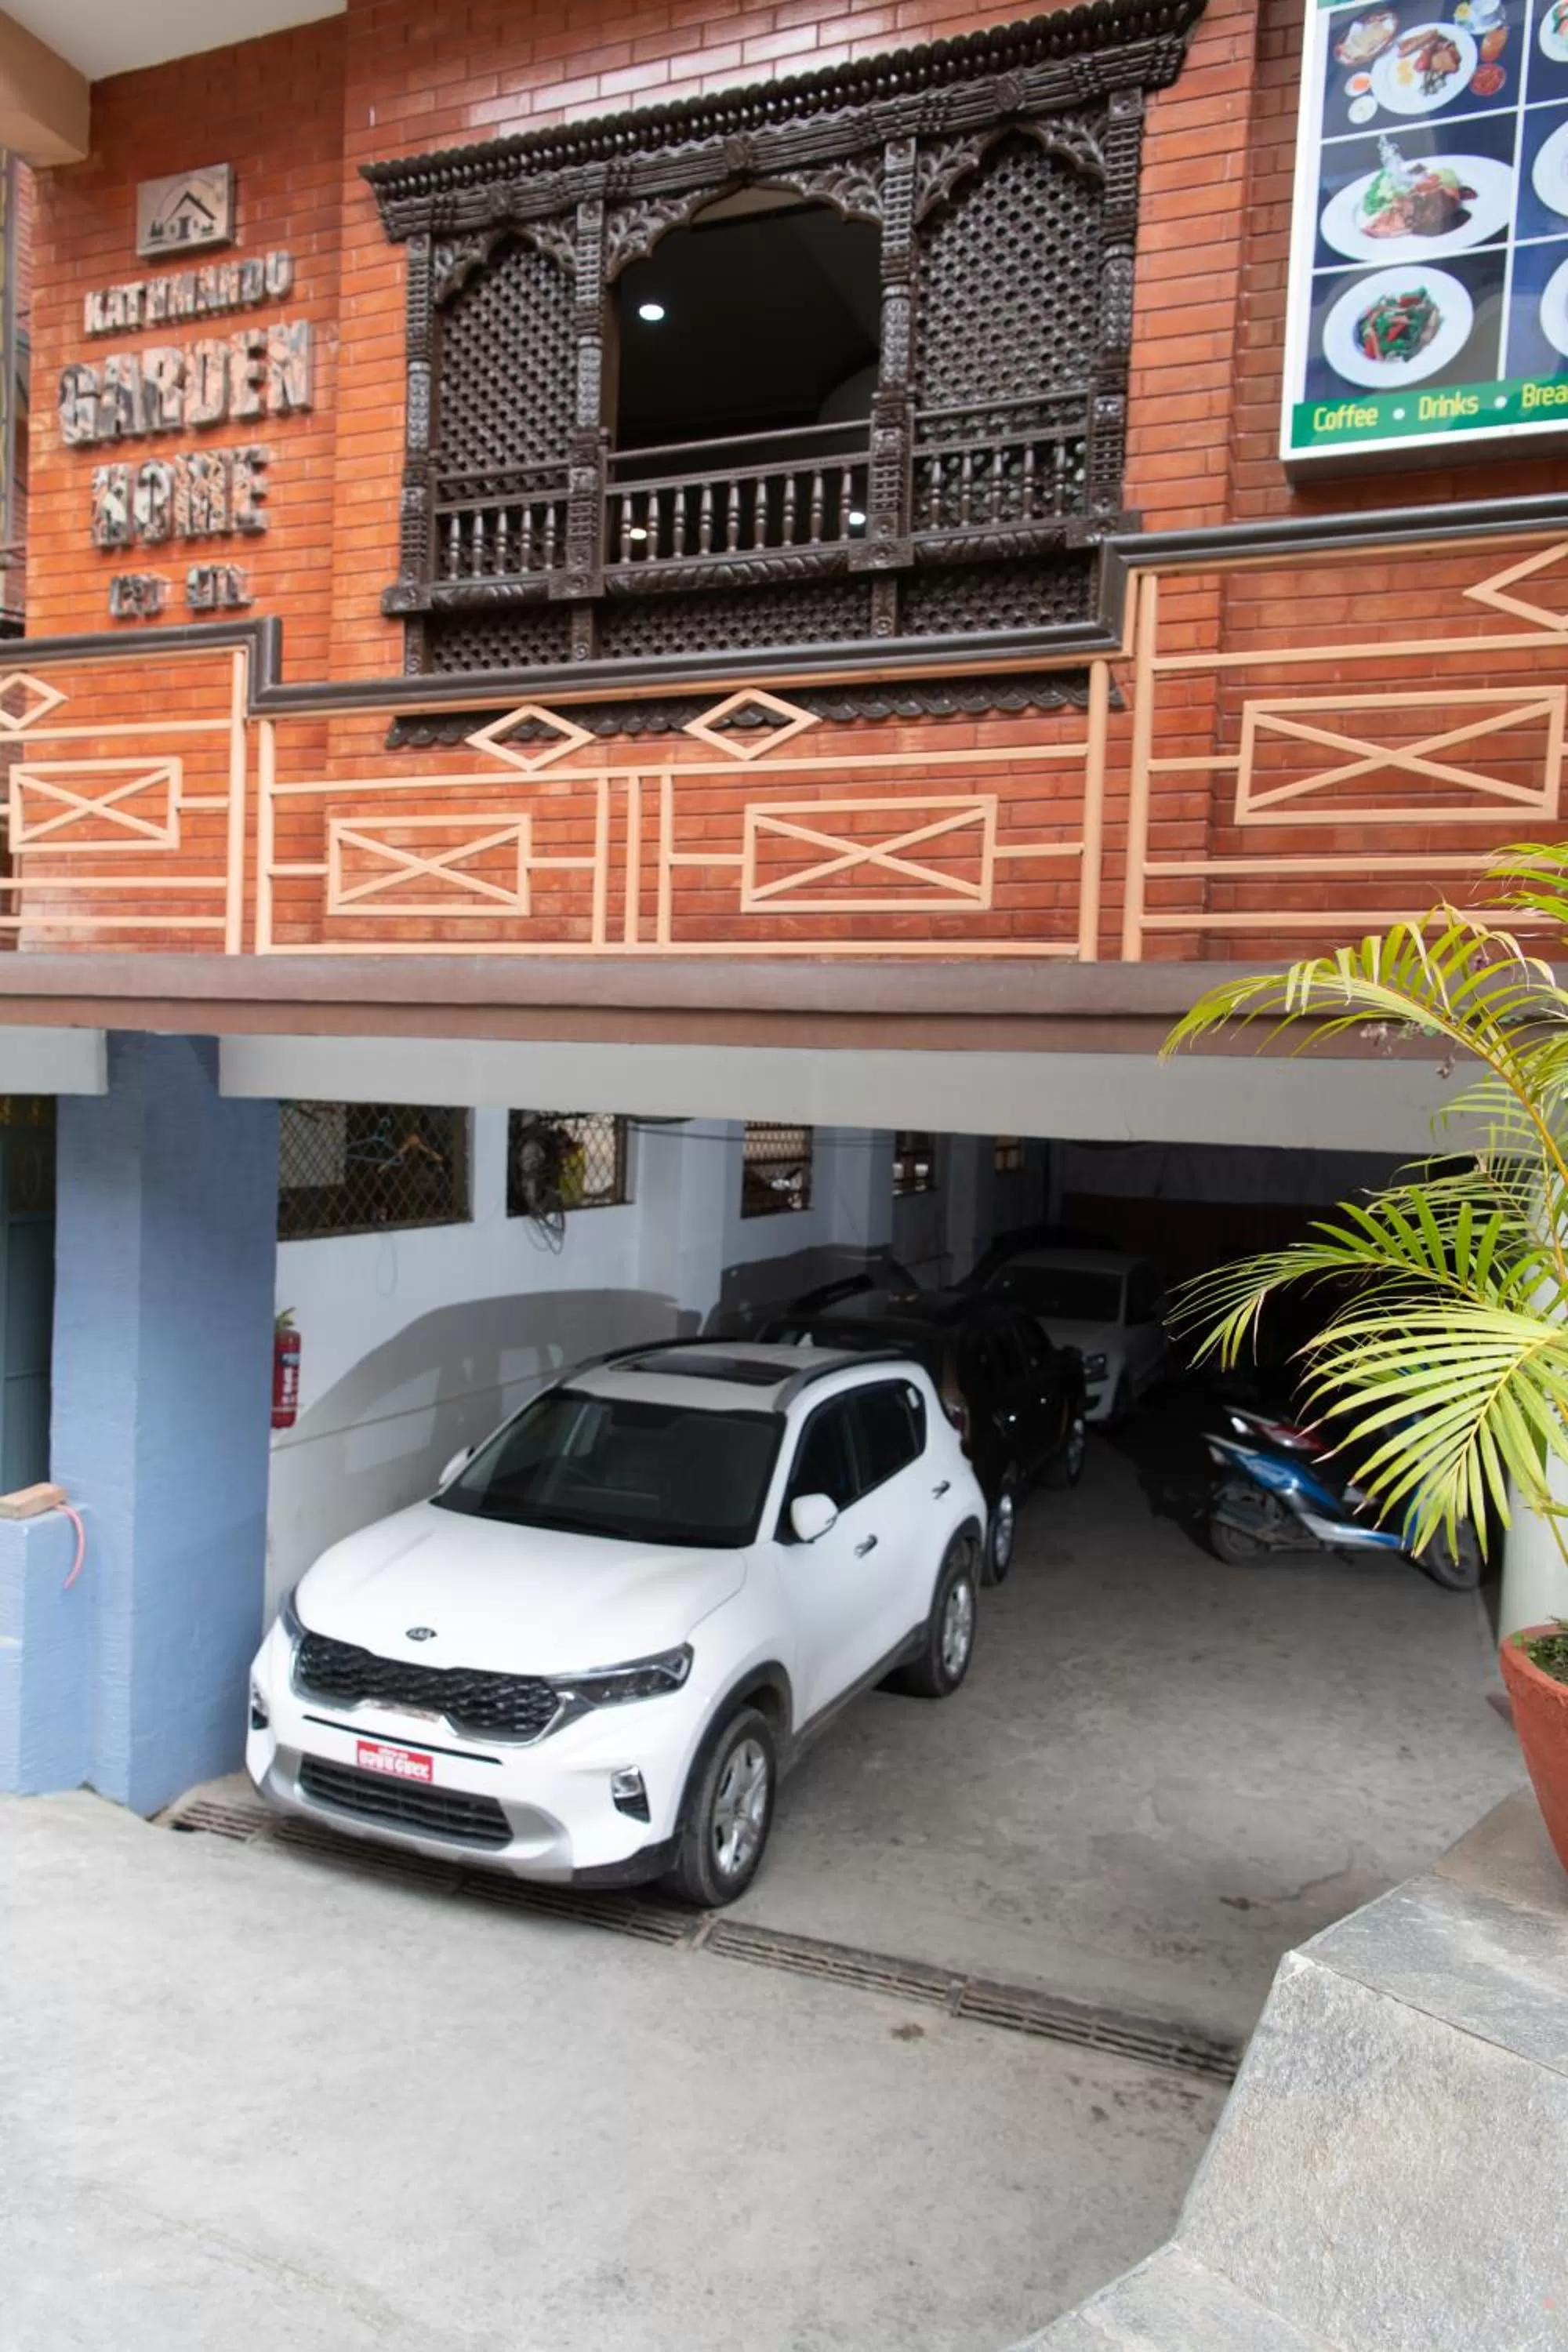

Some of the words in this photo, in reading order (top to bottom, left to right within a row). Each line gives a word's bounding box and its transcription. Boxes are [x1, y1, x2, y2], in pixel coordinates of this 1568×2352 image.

[84, 251, 292, 334] KATHMANDU
[59, 319, 312, 448] GARDEN
[1312, 404, 1380, 432] Coffee
[1417, 390, 1479, 421] Drinks
[91, 444, 270, 547] HOME
